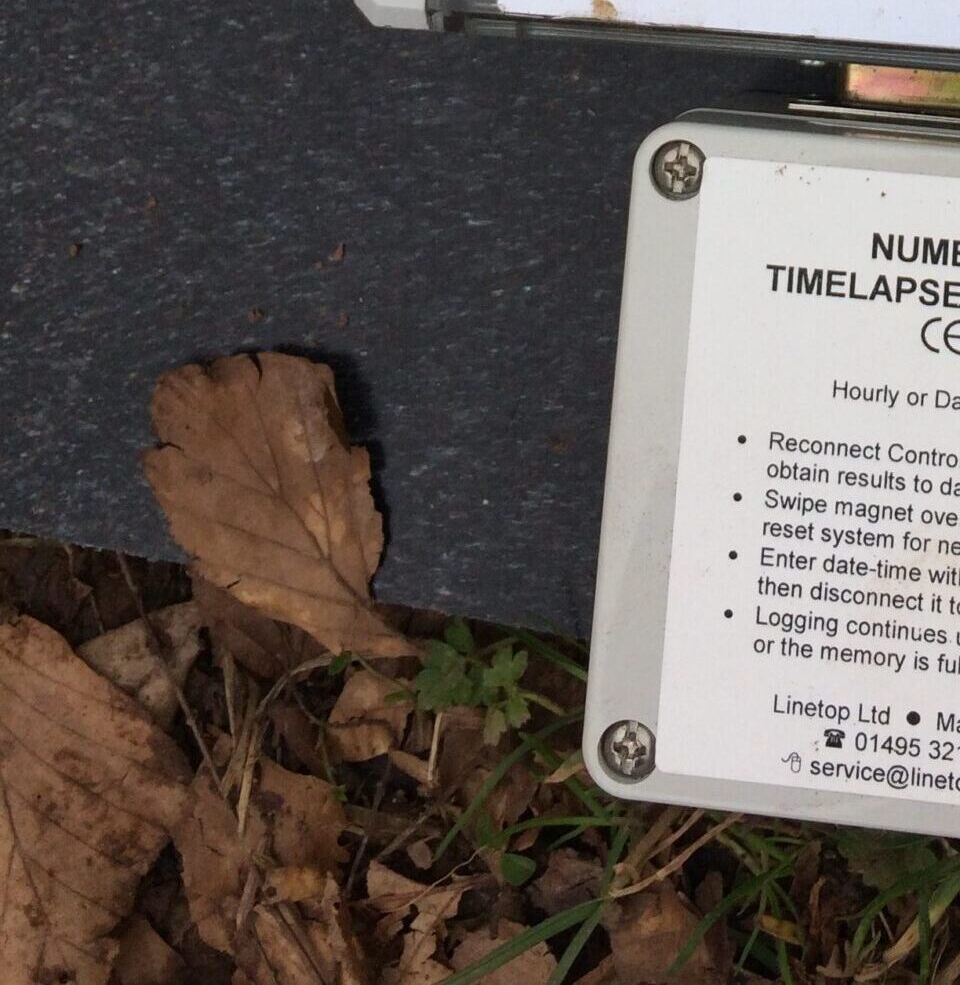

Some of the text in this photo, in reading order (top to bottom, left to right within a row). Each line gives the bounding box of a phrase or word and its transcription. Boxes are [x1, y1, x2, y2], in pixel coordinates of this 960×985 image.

[831, 379, 900, 410] Hourly
[906, 390, 929, 408] or
[768, 430, 882, 461] Reconnect
[766, 459, 830, 484] obtain
[837, 469, 907, 492] results
[912, 474, 934, 495] to
[764, 488, 828, 517] Swipe
[834, 500, 914, 525] magnet
[762, 521, 815, 542] reset
[820, 526, 895, 550] system
[902, 530, 932, 553] for
[759, 546, 818, 572] Enter
[821, 553, 923, 583] date-time
[757, 575, 803, 599] then
[808, 581, 925, 615] disconnect
[930, 592, 943, 615] it
[755, 604, 839, 639] Logging
[845, 619, 948, 646] continues
[752, 637, 776, 655] or
[780, 636, 814, 660] the
[819, 645, 907, 674] memory
[913, 650, 930, 672] is
[772, 693, 851, 726] Linetop
[857, 702, 892, 726] Ltd
[854, 731, 922, 758] 01495
